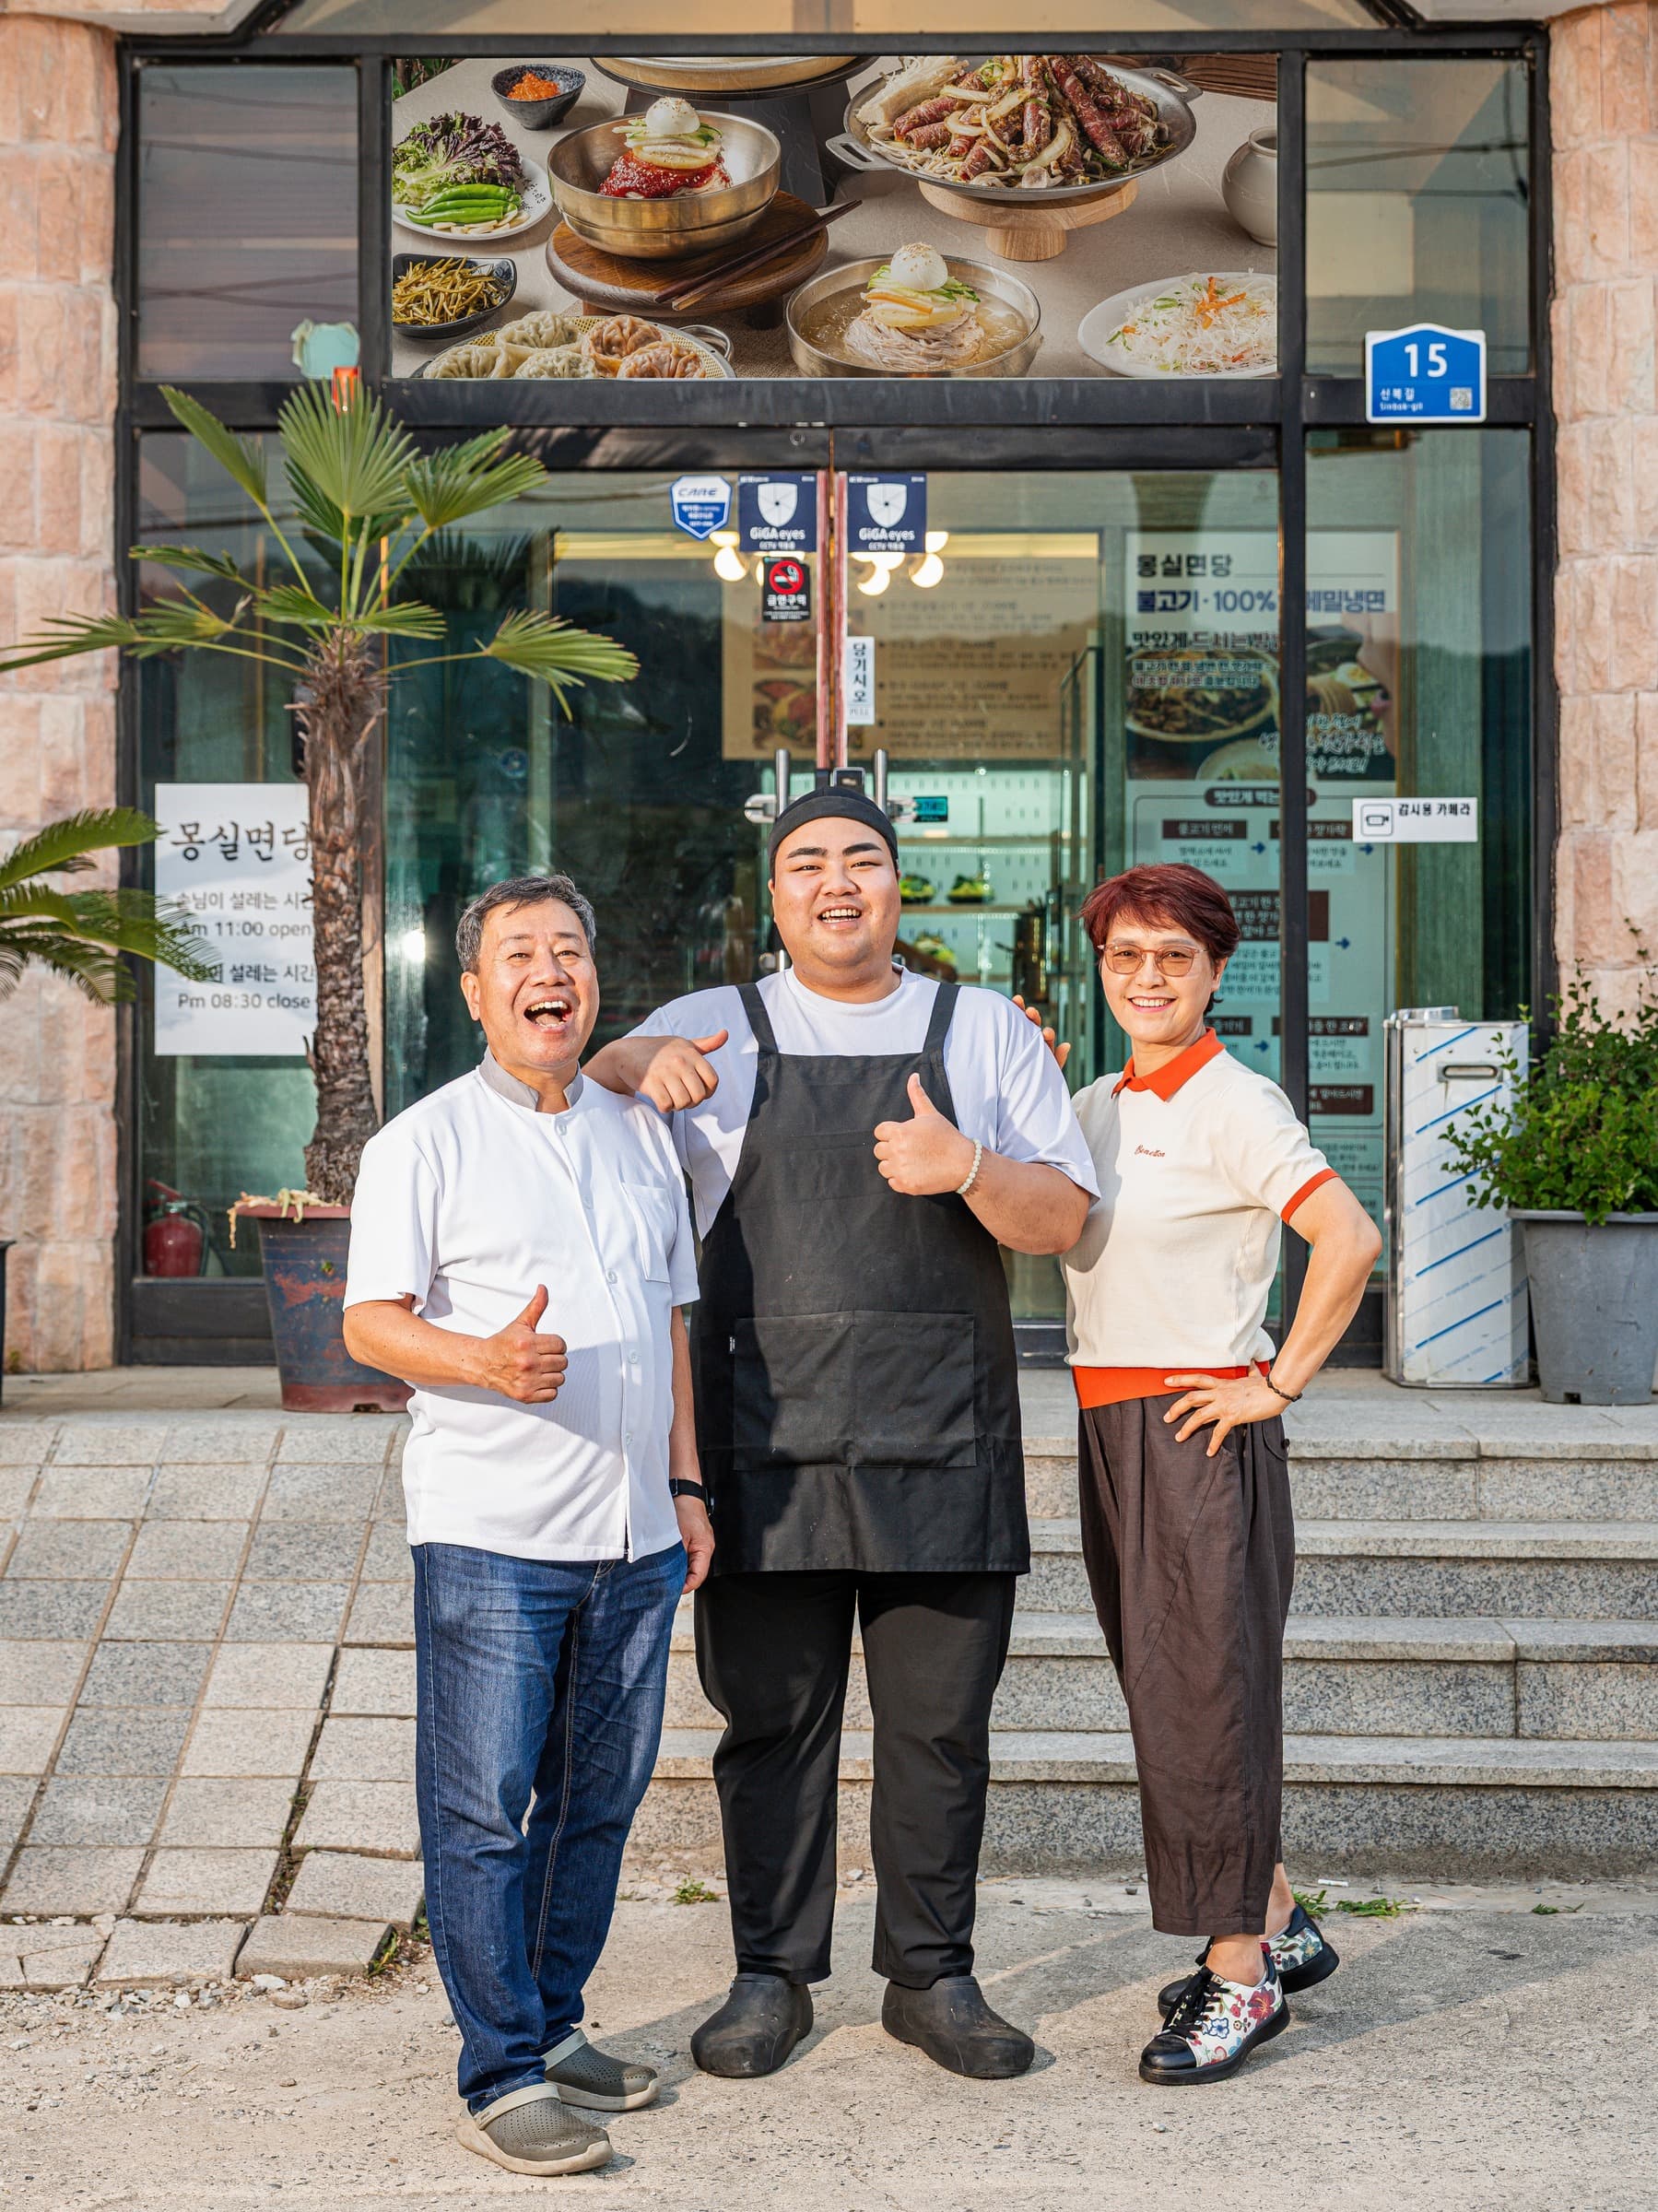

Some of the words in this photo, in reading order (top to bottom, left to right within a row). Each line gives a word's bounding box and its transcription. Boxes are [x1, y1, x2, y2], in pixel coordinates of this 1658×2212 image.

[1405, 343, 1447, 378] 15
[1137, 555, 1232, 578] 몽실면당
[767, 594, 806, 606] 금연구역
[1132, 631, 1187, 649] 맛있게
[853, 642, 867, 703] 당기시오
[1398, 803, 1432, 817] 감시용
[1437, 803, 1471, 817] 카메라
[170, 820, 311, 862] 몽실면당
[229, 891, 277, 911] 설레는
[215, 922, 264, 936] 11:00
[268, 924, 312, 940] open
[229, 964, 277, 983] 설레는
[178, 993, 206, 1009] Pm
[210, 993, 263, 1009] 08:30
[266, 993, 311, 1009] close
